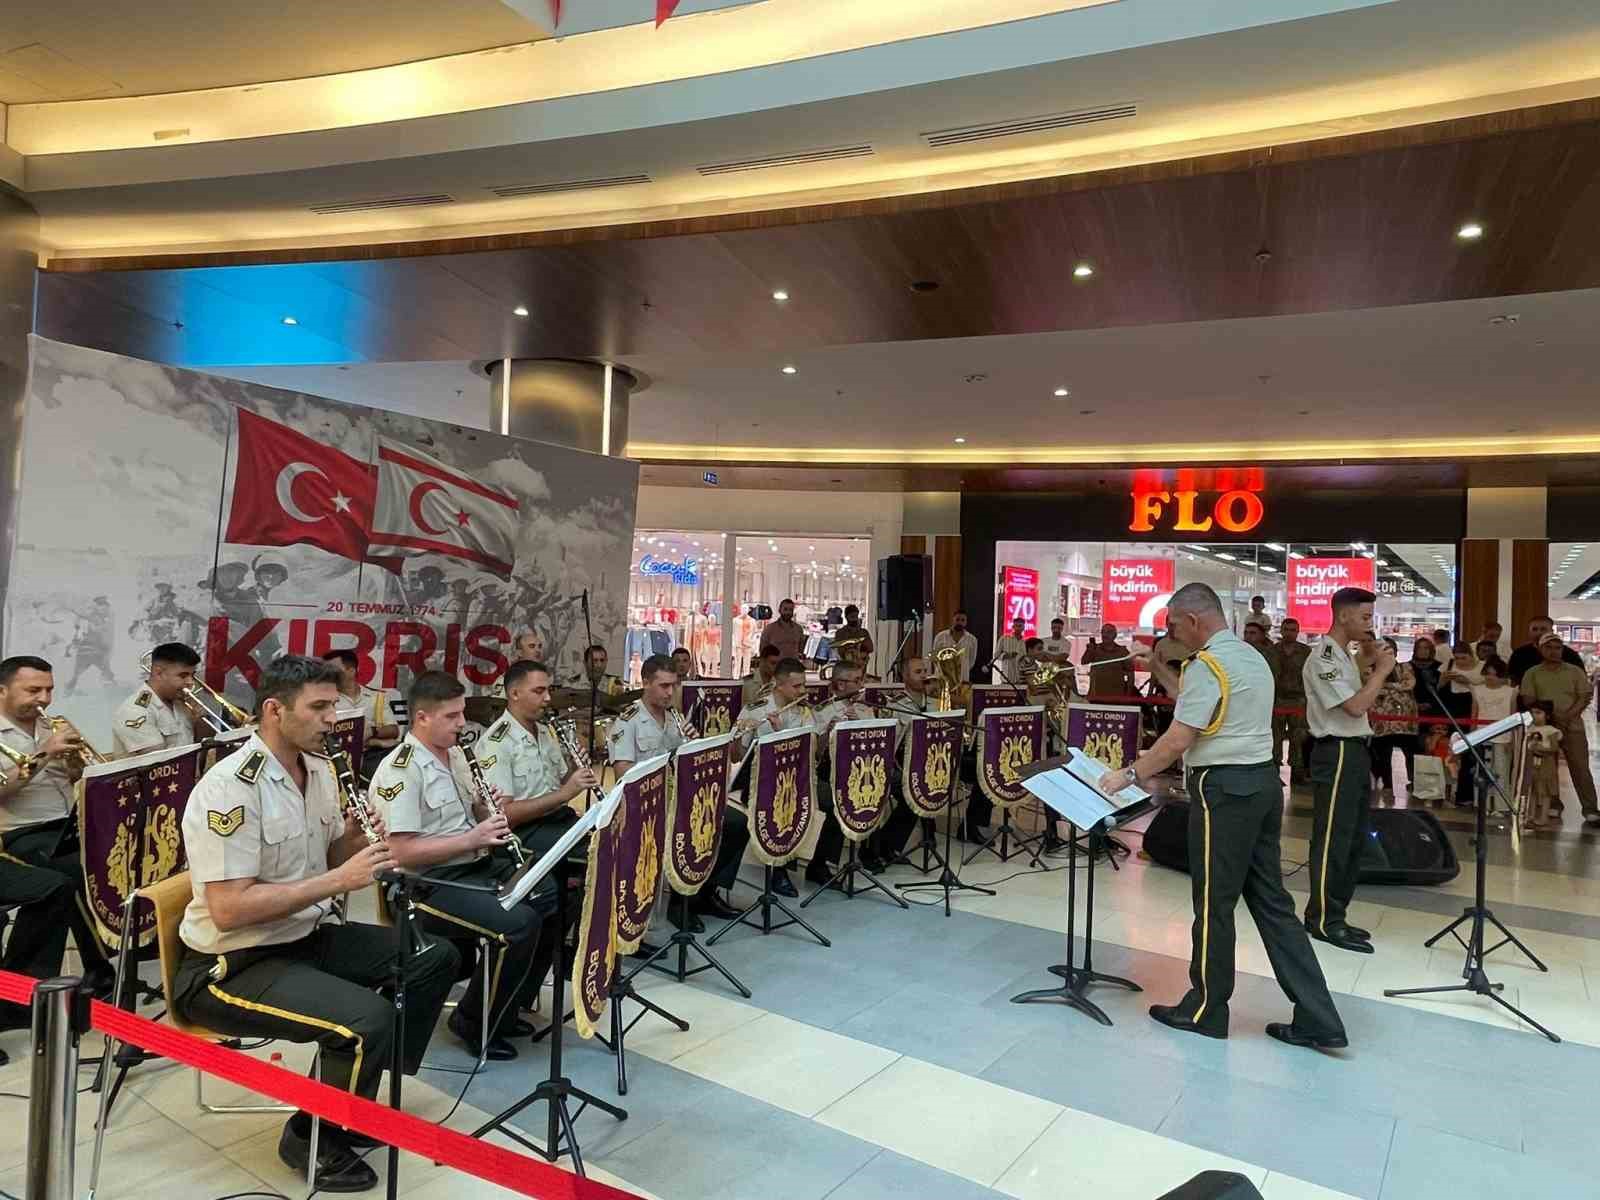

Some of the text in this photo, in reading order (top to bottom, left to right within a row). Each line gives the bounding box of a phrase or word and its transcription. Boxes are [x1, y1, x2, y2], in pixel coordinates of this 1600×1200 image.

[1129, 490, 1263, 532] FLO
[1110, 564, 1153, 579] büyük
[1296, 564, 1349, 580] büyük
[1110, 580, 1158, 593] indirim
[327, 601, 436, 616] 20 TEMMUZ 1974
[205, 616, 511, 693] KIBRIS
